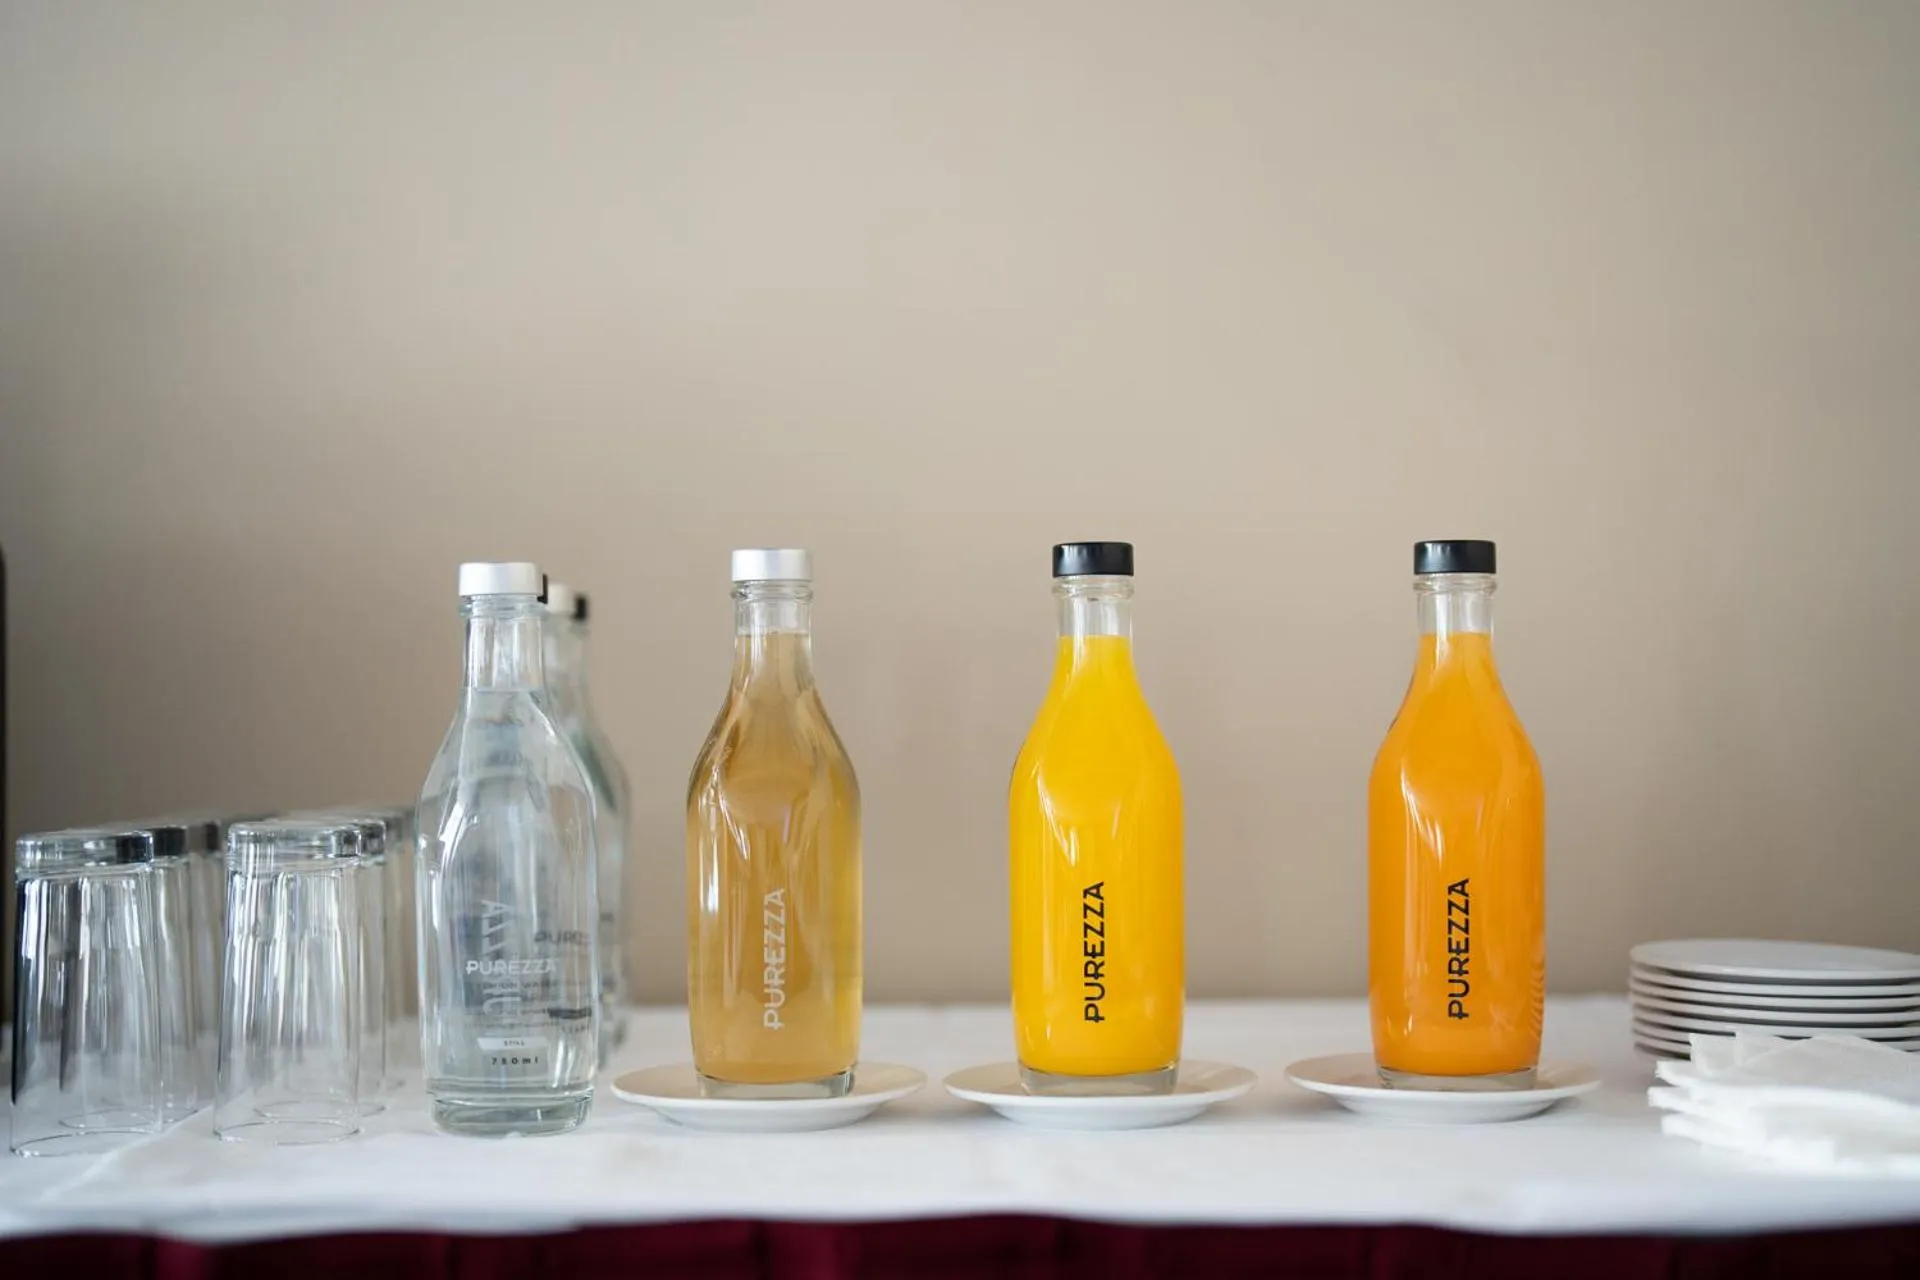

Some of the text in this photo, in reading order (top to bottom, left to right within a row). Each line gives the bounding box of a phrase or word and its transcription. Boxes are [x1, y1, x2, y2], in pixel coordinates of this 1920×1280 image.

[465, 958, 557, 975] PUREZZA
[763, 888, 786, 1031] PUREZZA
[1083, 881, 1106, 1023] PUREZZA
[1447, 877, 1470, 1020] PUREZZA
